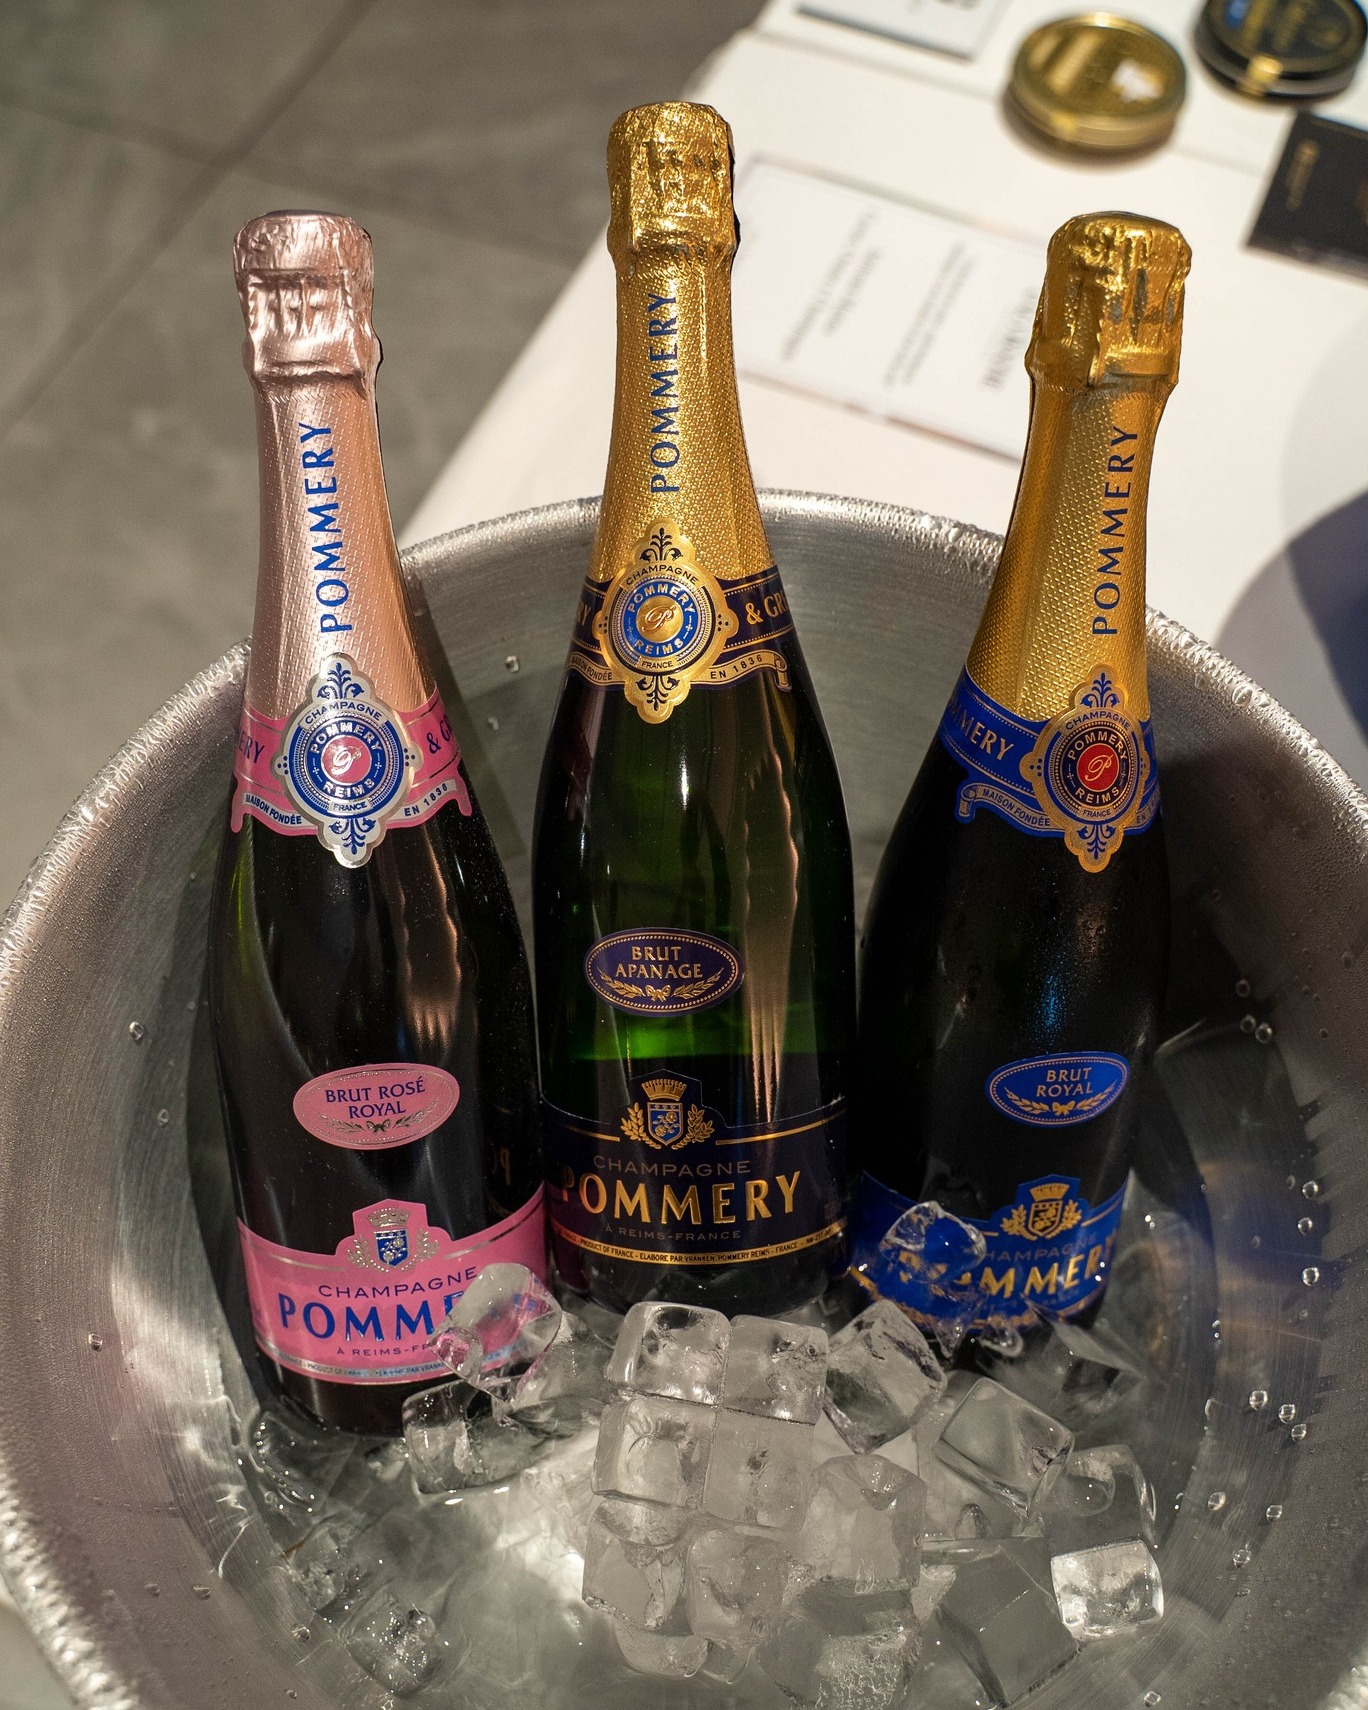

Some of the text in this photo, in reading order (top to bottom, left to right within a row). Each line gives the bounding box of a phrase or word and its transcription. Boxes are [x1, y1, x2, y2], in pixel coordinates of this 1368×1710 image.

[648, 292, 680, 493] POMMERY
[299, 422, 352, 633] POMMERY
[1092, 426, 1138, 634] POMMERY
[626, 565, 699, 586] CHAMPAGNE
[627, 583, 696, 613] POMMERY
[745, 602, 763, 624] &
[634, 637, 684, 656] REIMS
[587, 667, 613, 681] FONDÉE
[641, 660, 673, 669] FRANCE
[710, 654, 763, 680] EN 1836
[305, 702, 382, 724] CHAMPAGNE
[1065, 711, 1130, 730] CHAMPAGNE
[310, 721, 383, 753] POMMERY
[427, 732, 441, 754] &
[1067, 731, 1127, 760] POMMERY
[322, 777, 376, 799] REIMS
[1075, 787, 1121, 803] REIMS
[245, 794, 303, 825] MAISON FONDÉE
[333, 800, 368, 812] FRANCE
[404, 783, 448, 816] EN 1836
[981, 788, 1051, 827] MAISON FONDÉE
[1082, 808, 1112, 818] FRANCE
[631, 946, 682, 961] BRUT
[615, 964, 703, 979] APANAGE
[1046, 1067, 1092, 1083] BRUT
[325, 1076, 426, 1103] BRUT ROSÉ
[1036, 1082, 1093, 1097] ROYAL
[348, 1101, 406, 1119] ROYAL
[593, 1155, 751, 1178] CHAMPAGNE
[562, 1166, 801, 1226] POMMERY
[603, 1245, 610, 1253] OF
[611, 1247, 634, 1258] FRANCE
[670, 1254, 683, 1262] PAR
[775, 1241, 798, 1253] FRANCE
[319, 1266, 478, 1298] CHAMPAGNE
